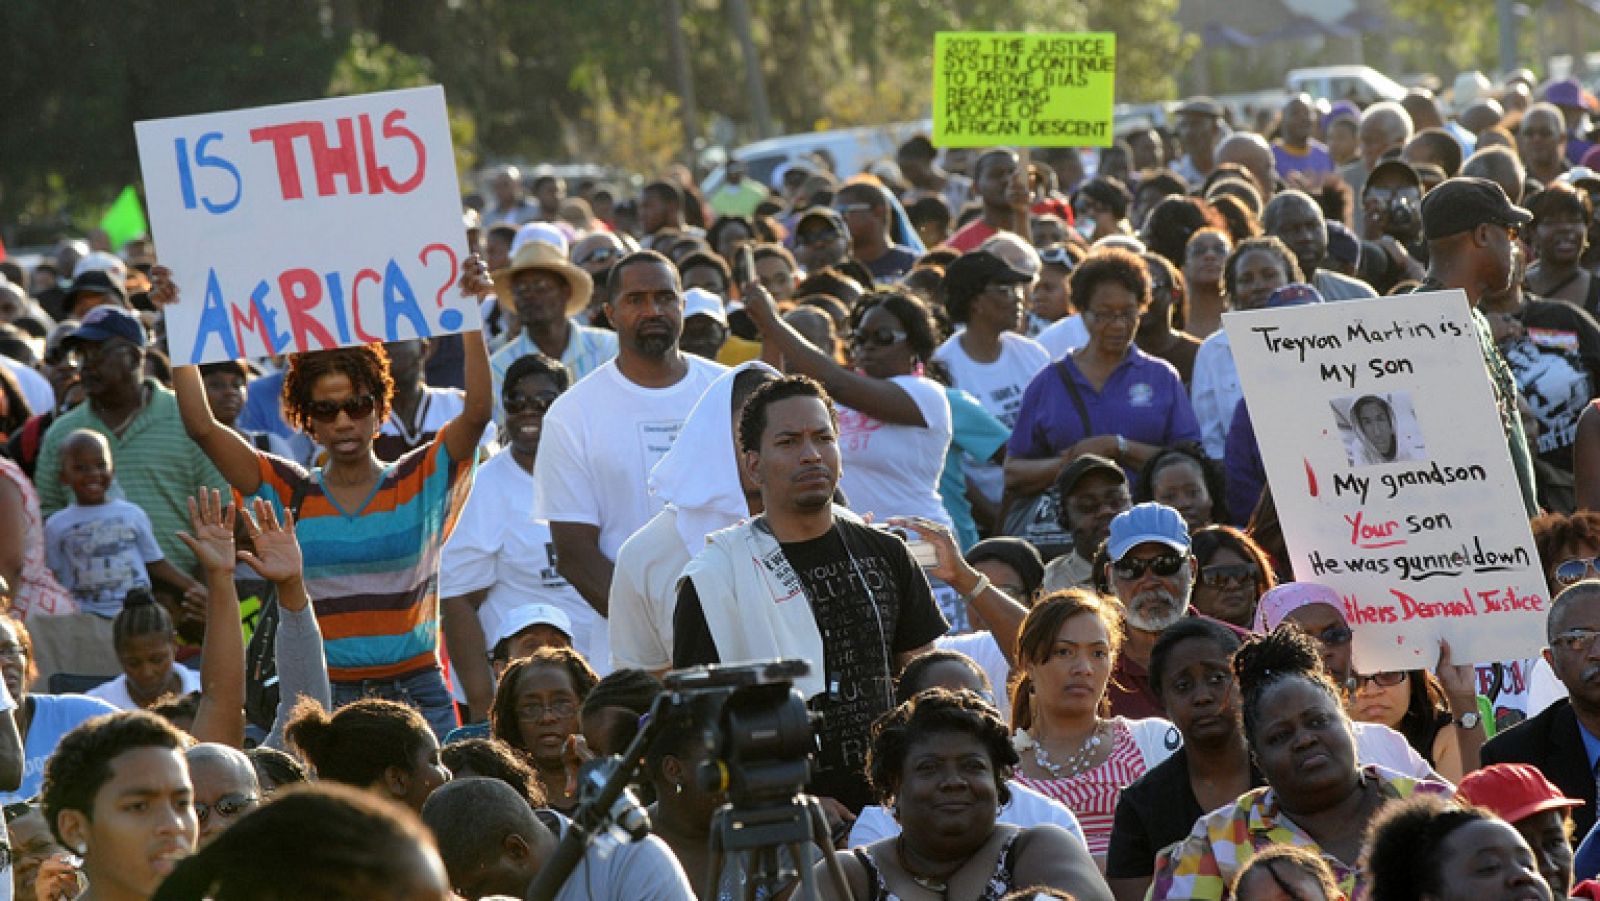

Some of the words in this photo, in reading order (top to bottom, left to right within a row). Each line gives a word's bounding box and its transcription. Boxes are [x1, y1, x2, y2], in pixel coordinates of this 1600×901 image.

[991, 39, 1025, 54] THE
[1033, 39, 1105, 55] JUSTICE
[944, 54, 1019, 70] SYSTEM
[1027, 55, 1115, 72] CONTINUE
[944, 71, 967, 85] TO
[977, 71, 1033, 86] PROVE
[946, 87, 1051, 103] REGARDING
[946, 102, 1011, 118] PEOPLE
[1018, 103, 1043, 119] OF
[944, 120, 1020, 136] AFRICAN
[1029, 120, 1108, 136] DESCENT
[174, 132, 242, 215] IS
[250, 108, 426, 200] THIS
[190, 243, 464, 365] AMERICA?
[1347, 320, 1436, 344] Martin
[1333, 472, 1370, 504] My
[1381, 462, 1487, 499] grandson
[1344, 511, 1400, 545] Your
[1308, 550, 1343, 576] He
[1343, 555, 1389, 574] was
[1473, 535, 1530, 567] down
[1343, 592, 1399, 625] thers
[1389, 586, 1477, 620] Demand
[1476, 585, 1545, 613] Justice
